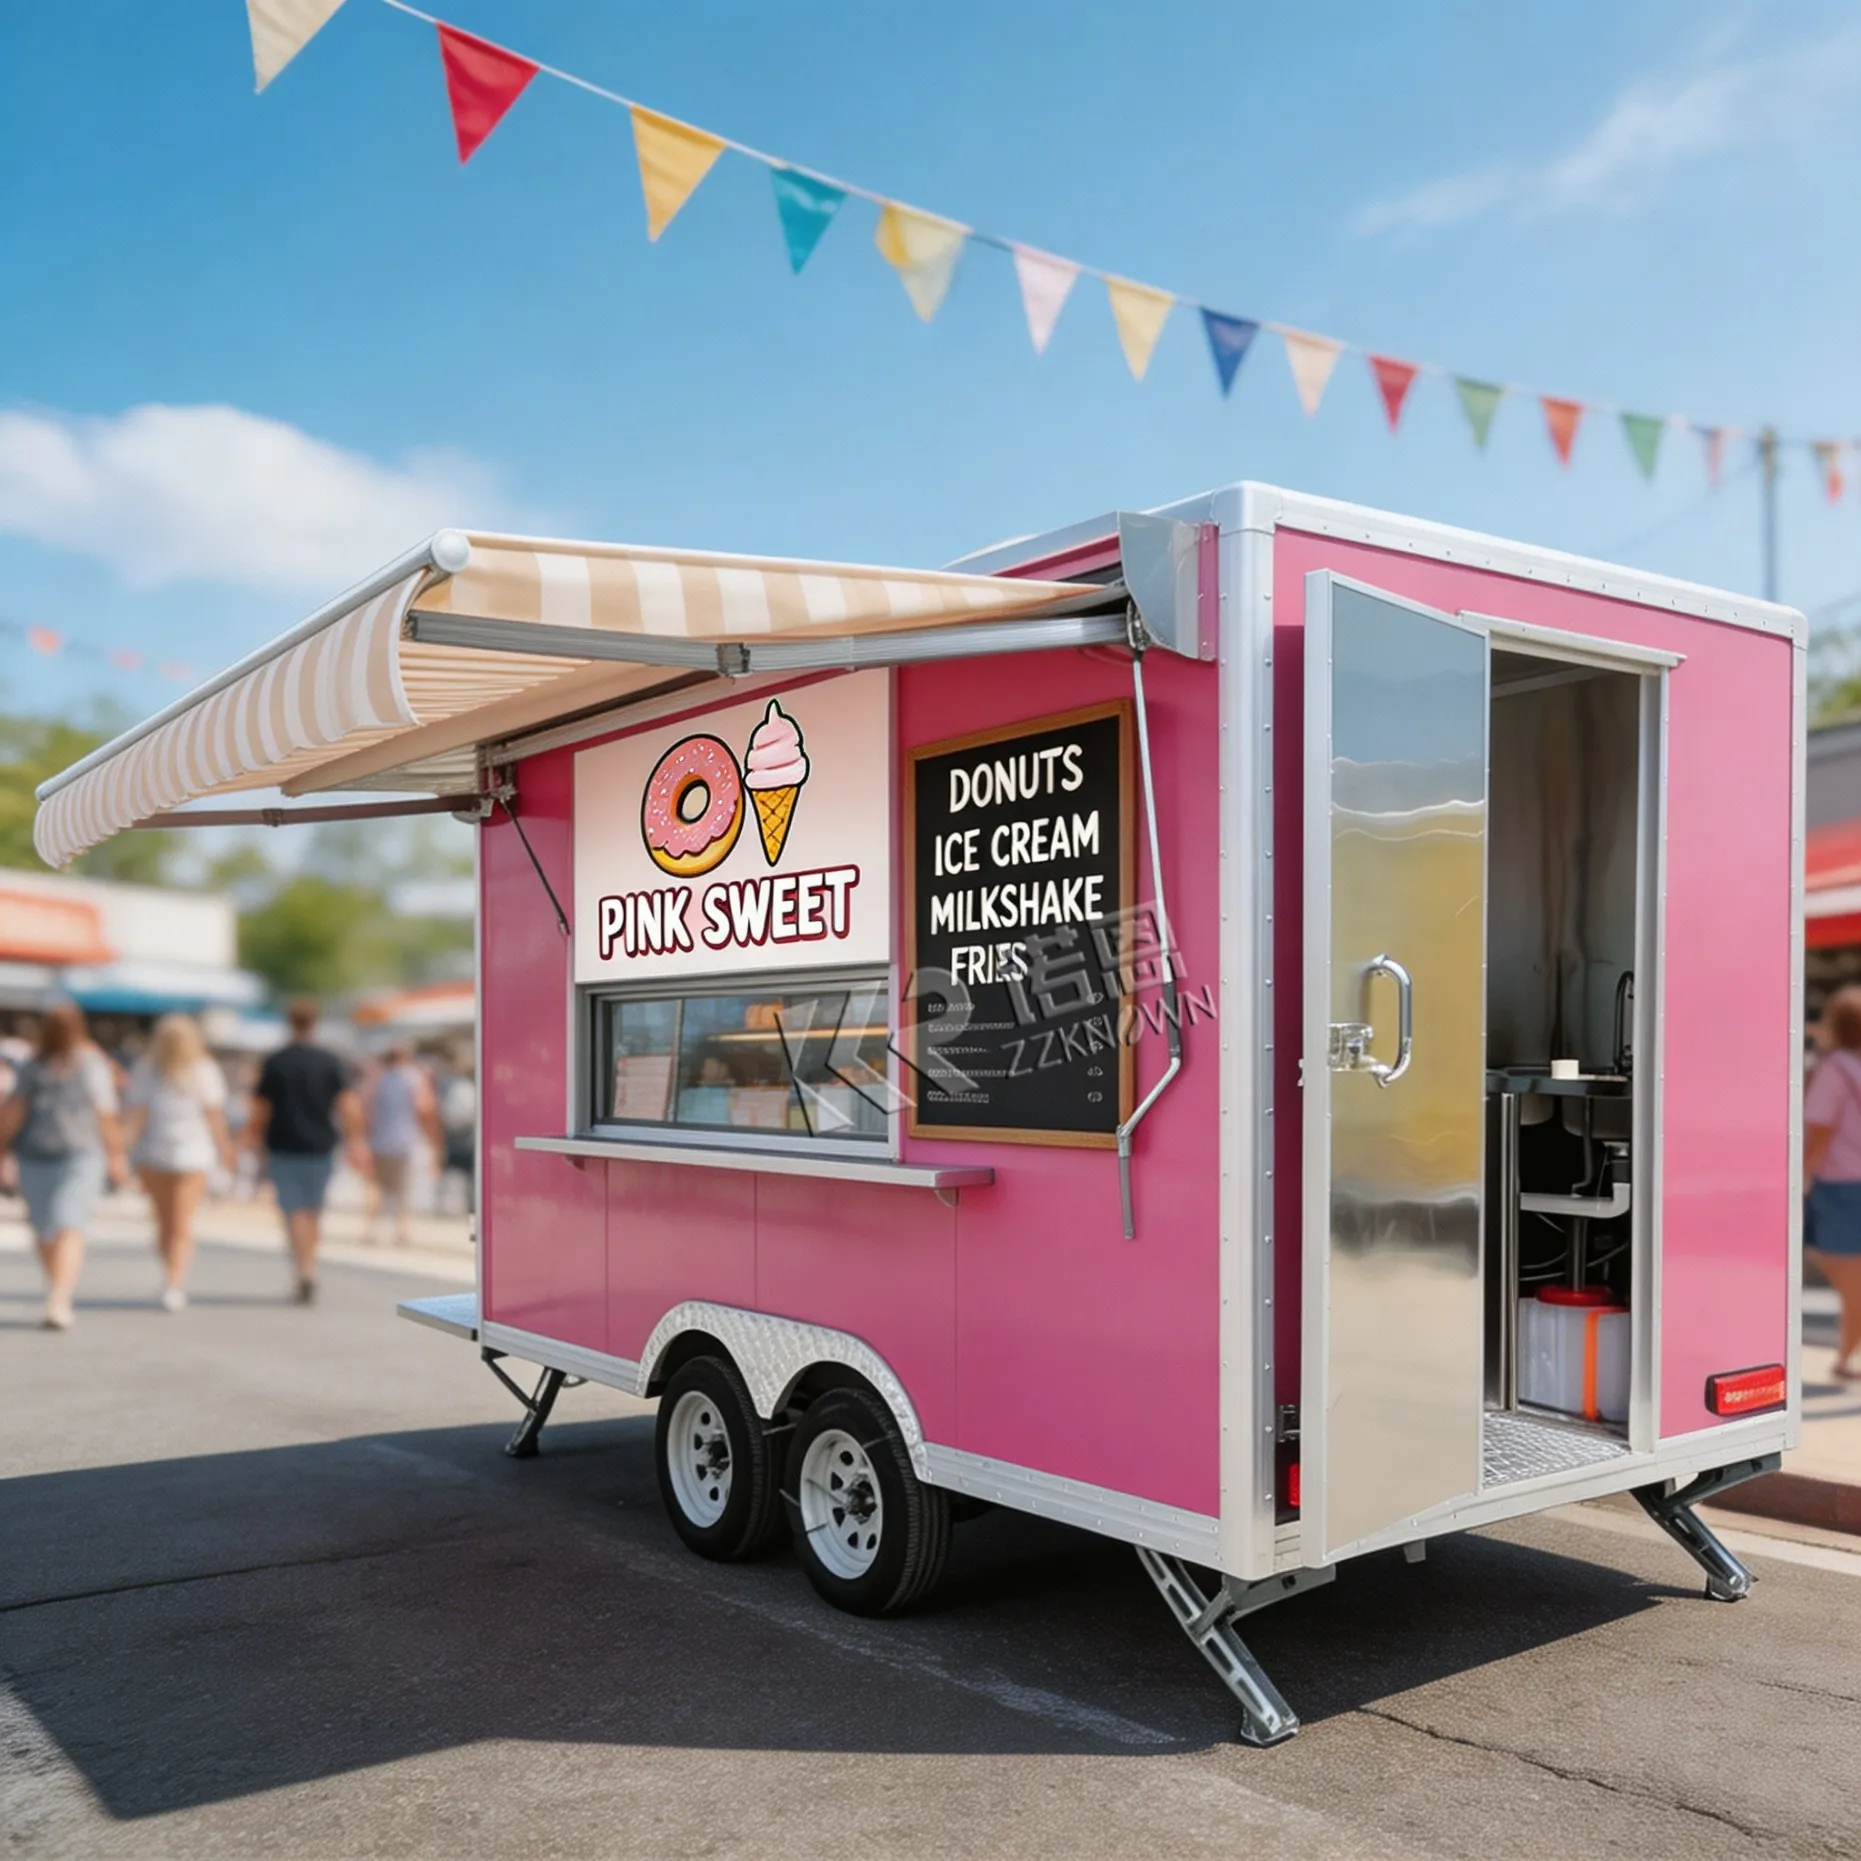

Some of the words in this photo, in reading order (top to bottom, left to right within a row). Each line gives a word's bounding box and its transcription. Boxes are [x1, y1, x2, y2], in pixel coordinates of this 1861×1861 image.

[949, 744, 1084, 813] DONUTS
[934, 829, 980, 876] ICE
[991, 811, 1099, 867] CREAM
[599, 886, 694, 960] PINK
[701, 864, 860, 949] SWEET
[930, 875, 1104, 935] MILKSHAKE
[950, 941, 1028, 986] FRIES
